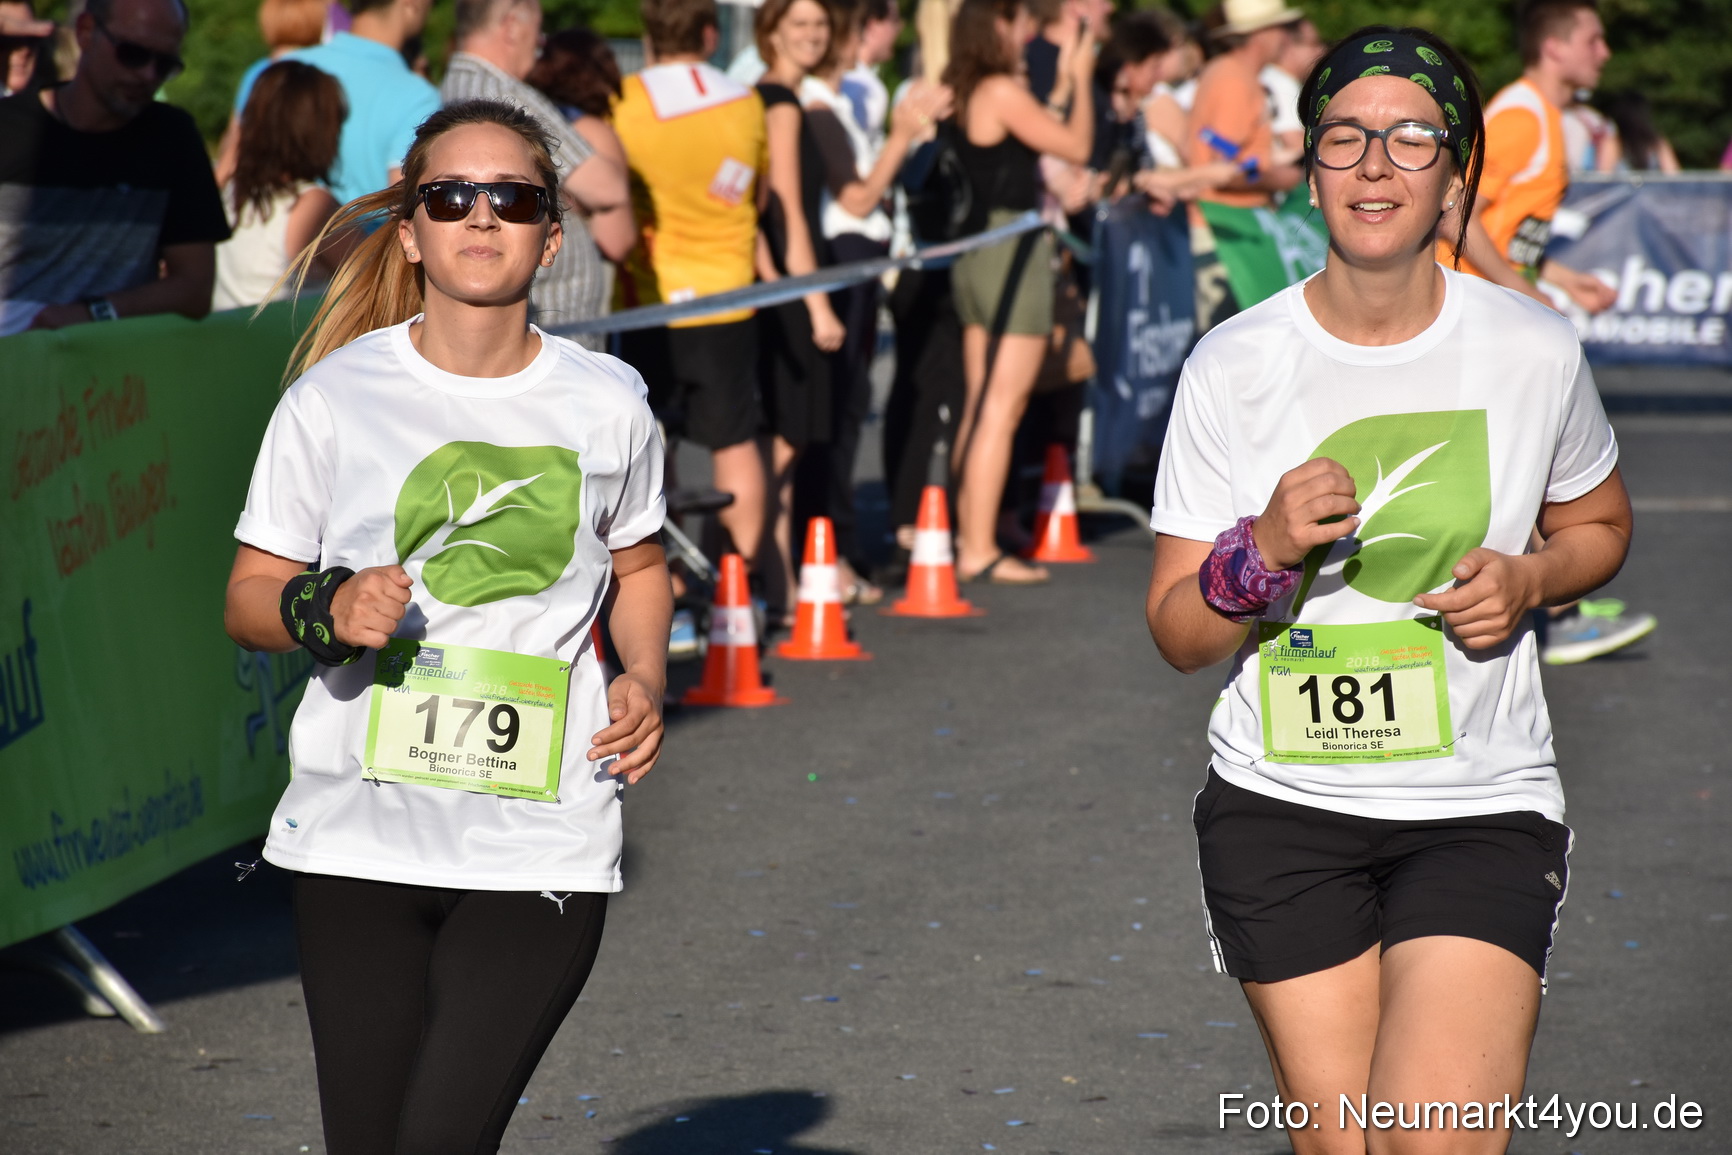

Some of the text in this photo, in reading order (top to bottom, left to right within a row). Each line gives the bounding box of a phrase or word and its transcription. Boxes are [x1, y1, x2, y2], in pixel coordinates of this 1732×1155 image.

[1280, 645, 1337, 659] firmenlauf
[1346, 656, 1380, 668] 2018
[473, 682, 508, 695] 2018
[1299, 673, 1395, 724] 181
[416, 695, 520, 753] 179
[1306, 726, 1401, 739] Leidl Theresa
[1322, 741, 1384, 750] Bionorica SE
[409, 746, 517, 770] Bogner Bettina
[429, 764, 493, 779] Bionorica SE
